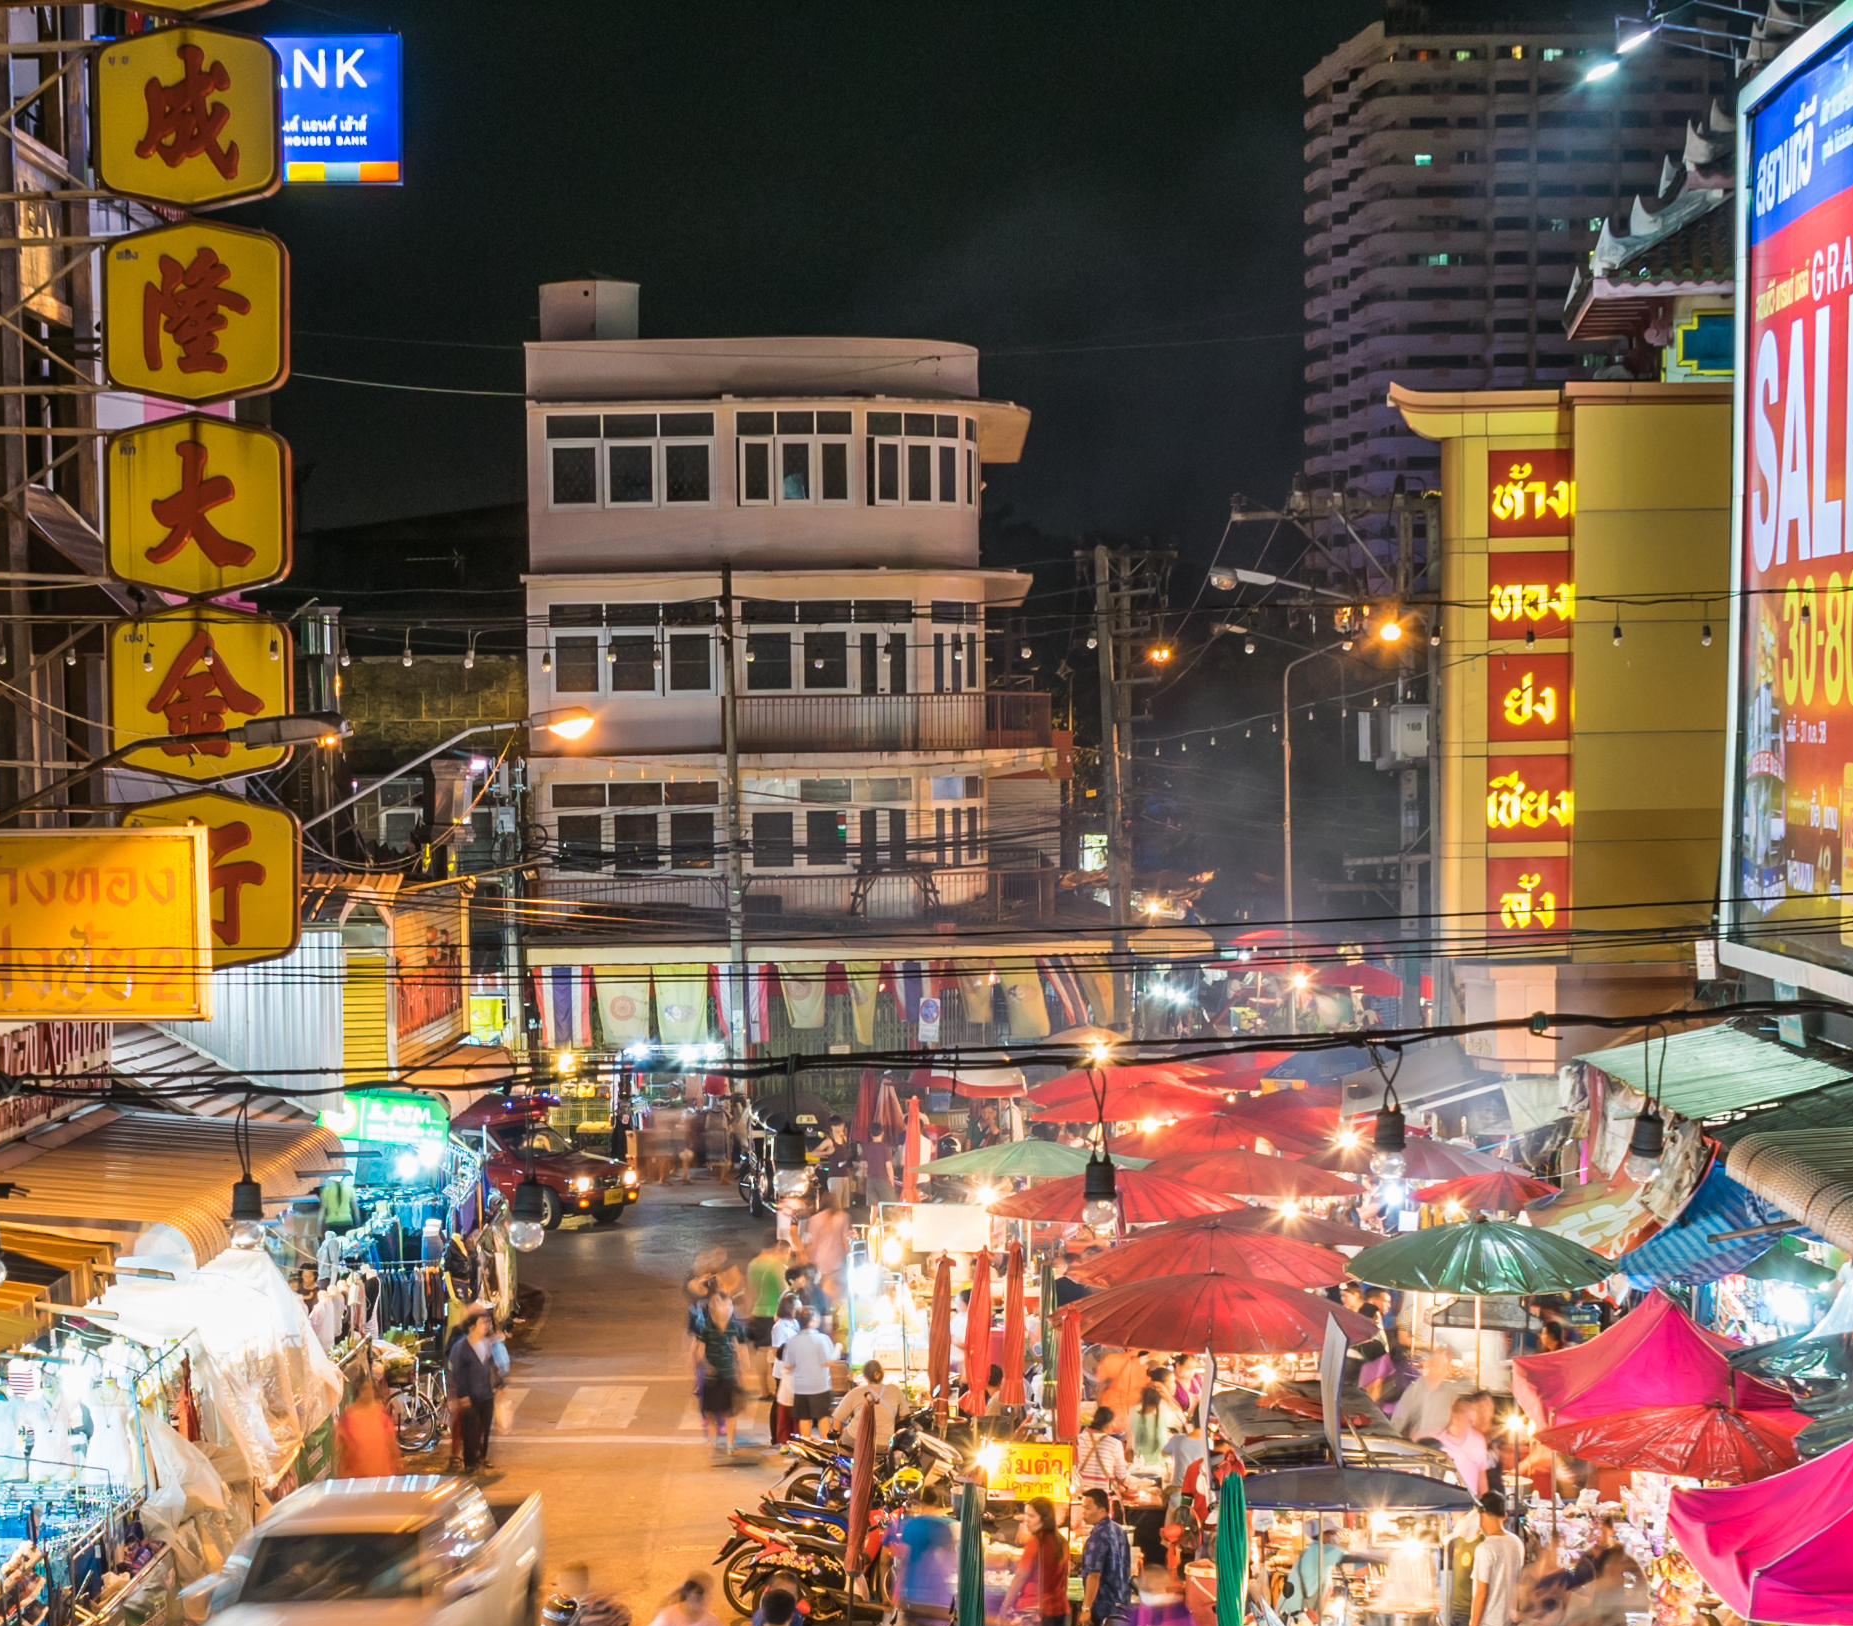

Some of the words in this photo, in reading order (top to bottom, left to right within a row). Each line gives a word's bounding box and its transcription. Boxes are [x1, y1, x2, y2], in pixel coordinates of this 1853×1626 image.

[279, 47, 368, 88] NK
[336, 136, 368, 149] BANK
[1491, 462, 1575, 521] ห้าง
[1490, 583, 1576, 622] ทอง
[1486, 770, 1575, 829] เชียง
